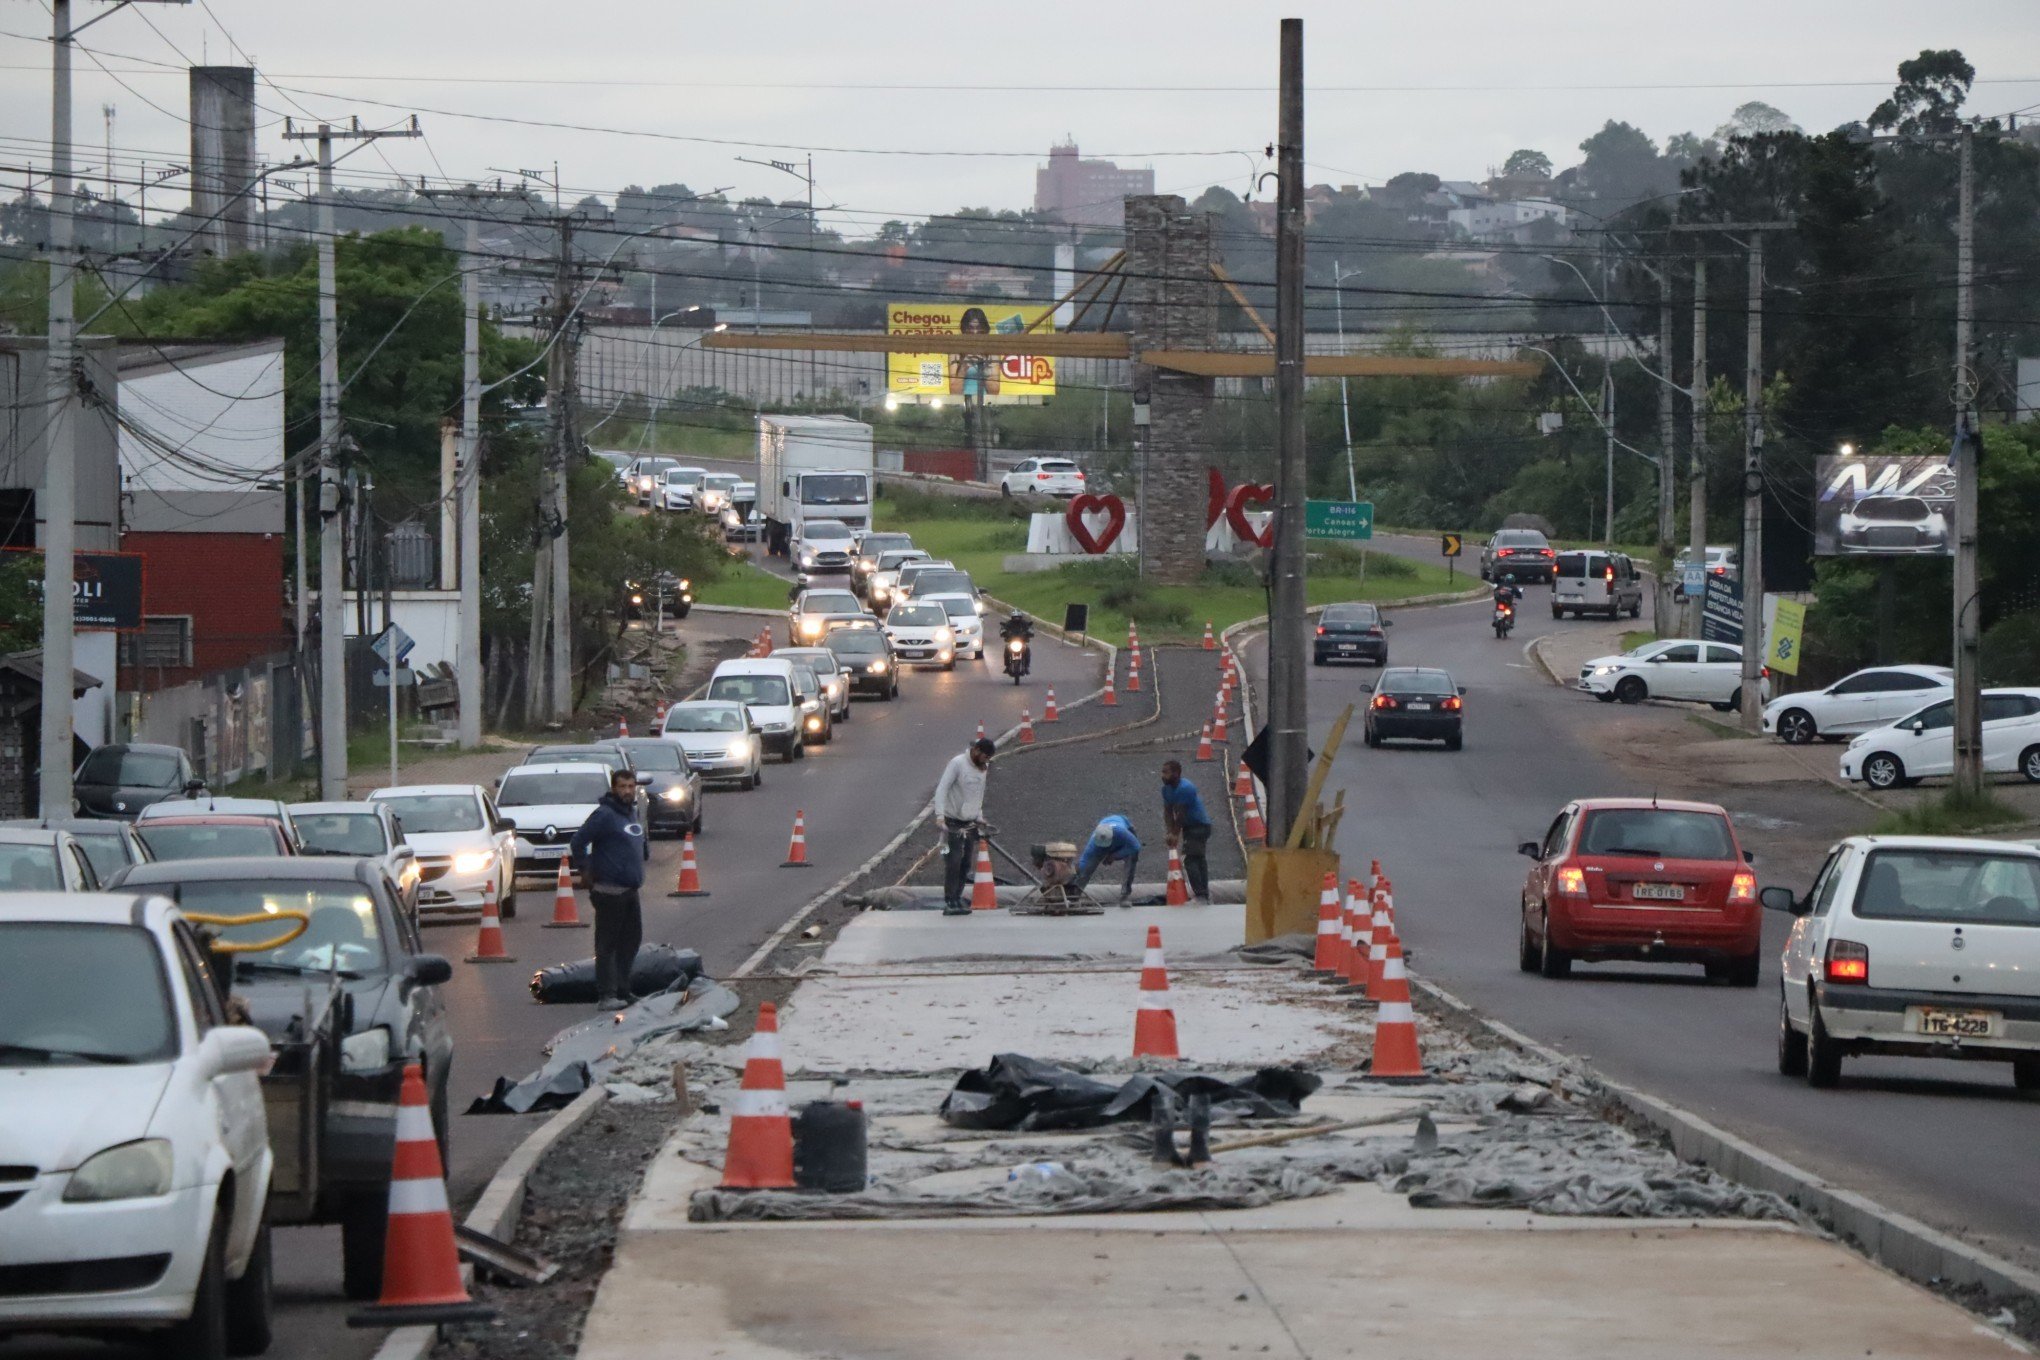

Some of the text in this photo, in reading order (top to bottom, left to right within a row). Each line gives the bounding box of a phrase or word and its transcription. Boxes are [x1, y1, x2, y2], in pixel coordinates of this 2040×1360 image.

[892, 311, 951, 327] Chegou
[1002, 355, 1049, 384] Clip
[1329, 507, 1357, 515] BR-116
[1324, 518, 1356, 526] Canoas
[1328, 528, 1355, 537] Alegre
[1709, 579, 1732, 594] OBRA DA
[1708, 589, 1737, 607] PREFEITURA
